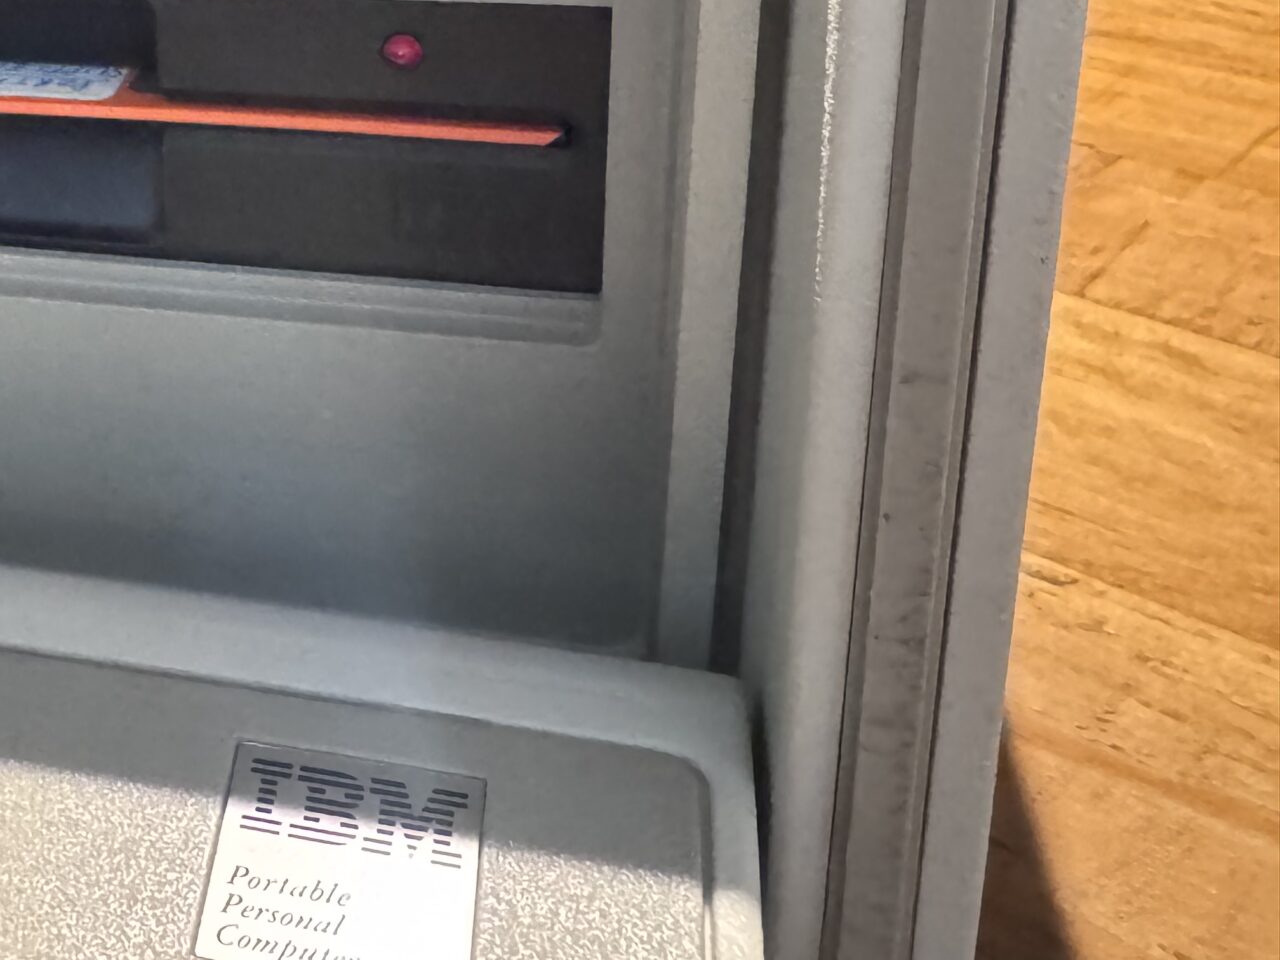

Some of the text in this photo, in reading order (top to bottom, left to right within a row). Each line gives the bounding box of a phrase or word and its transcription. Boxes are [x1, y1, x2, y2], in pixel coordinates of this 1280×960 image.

[239, 757, 469, 870] IBM
[226, 864, 352, 907] Portable
[220, 892, 347, 937] Personal
[216, 923, 361, 960] Comput
